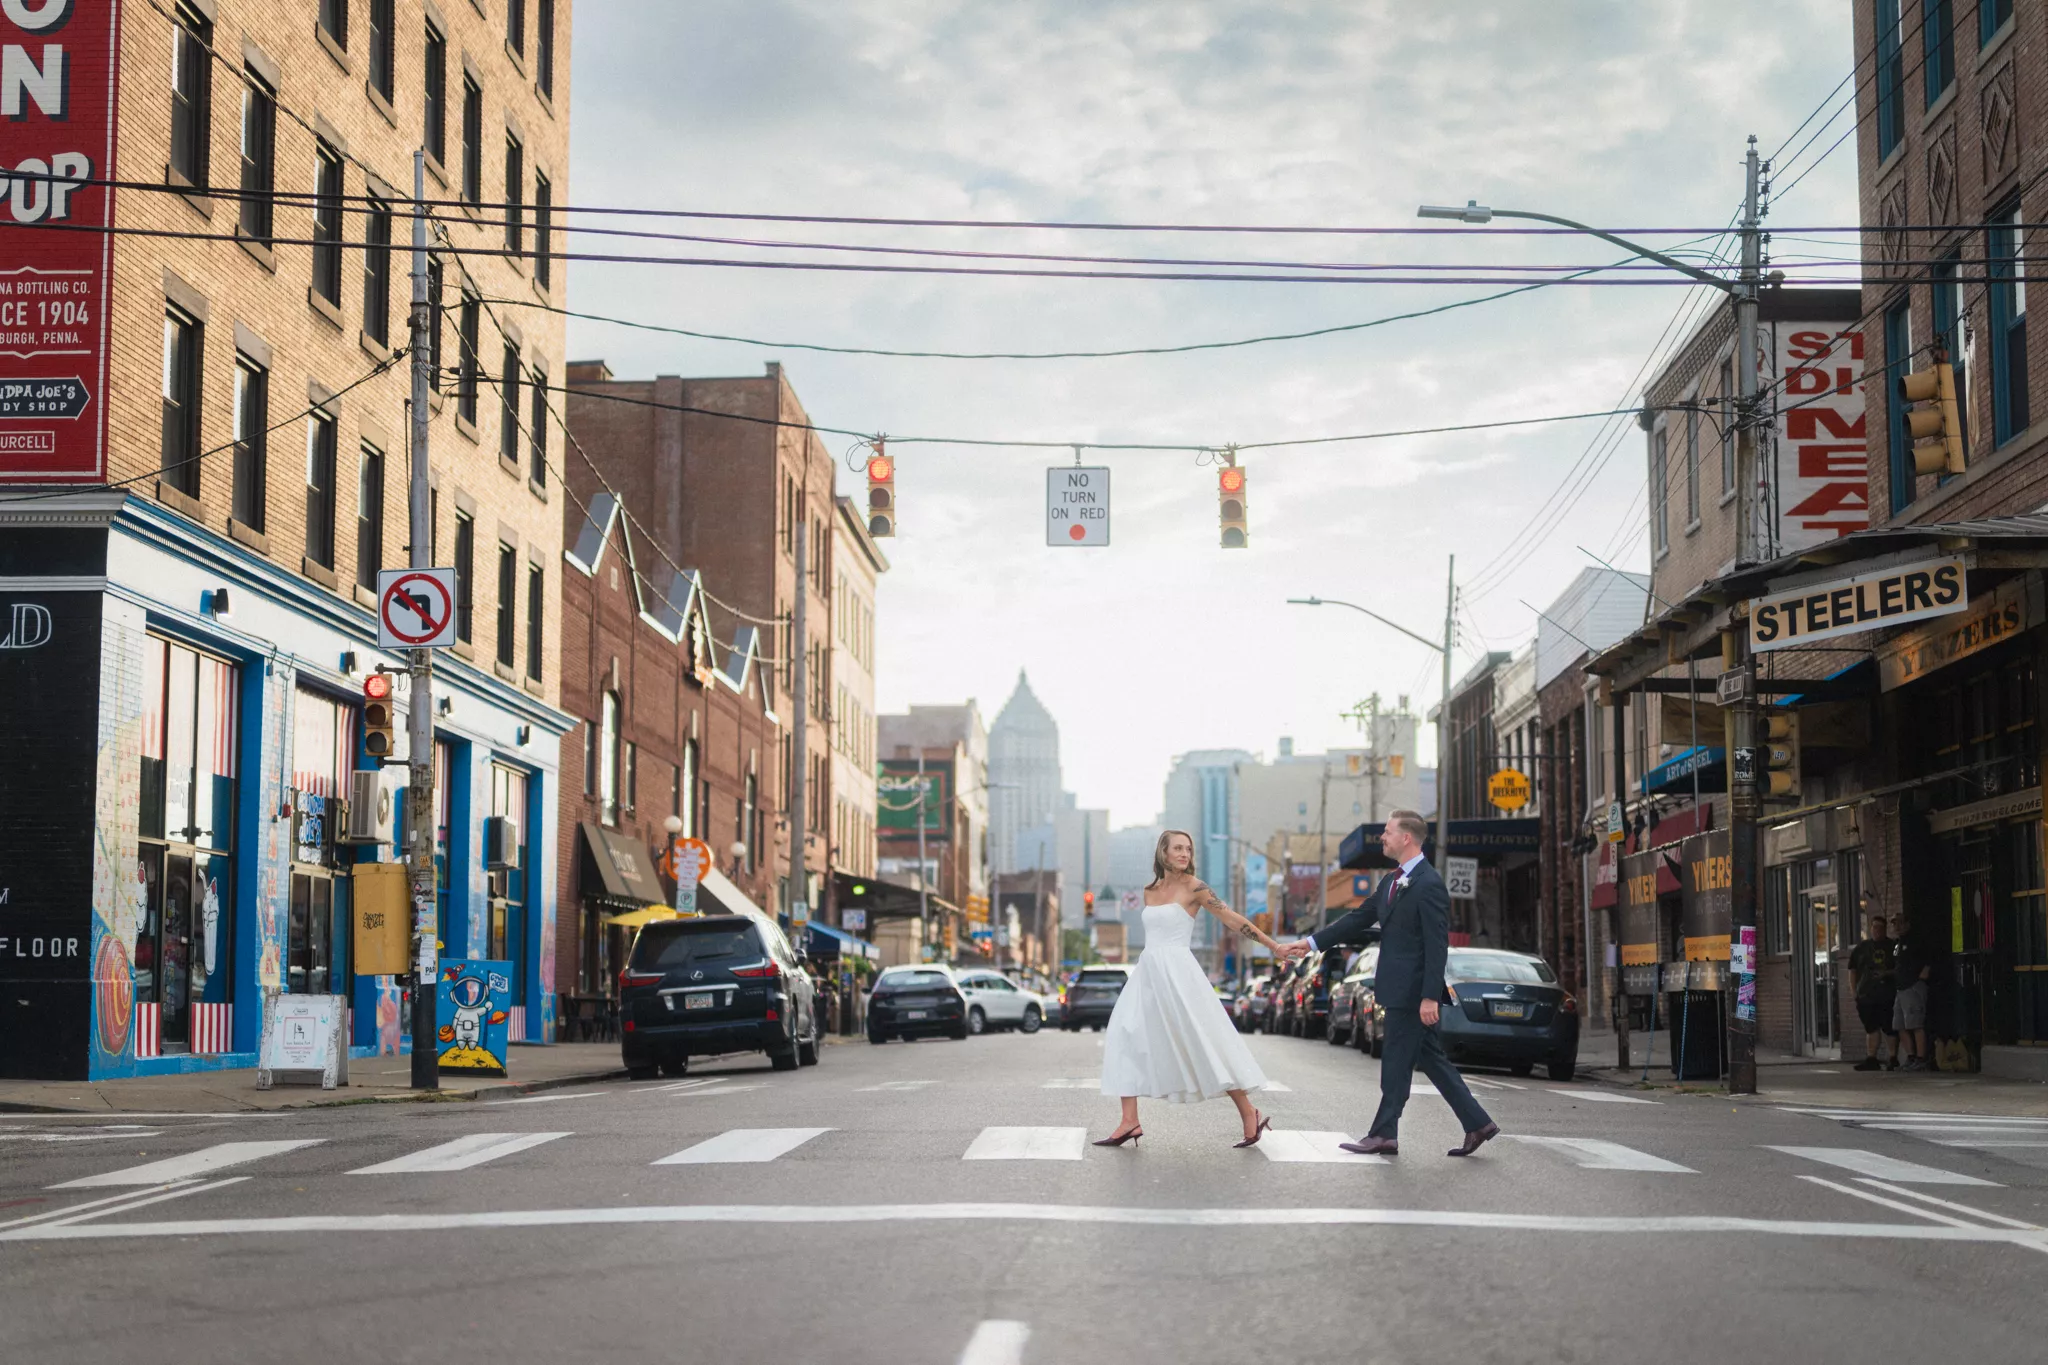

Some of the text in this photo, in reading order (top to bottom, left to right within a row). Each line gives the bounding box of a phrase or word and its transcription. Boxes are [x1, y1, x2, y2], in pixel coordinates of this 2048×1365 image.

[0, 152, 90, 222] OP
[17, 281, 69, 295] BOTTLING
[73, 281, 91, 294] CO.
[38, 301, 89, 326] 1904
[0, 332, 82, 345] BURGH, PENNA.
[1785, 367, 1865, 395] DI
[36, 384, 76, 399] JOE'S
[28, 402, 67, 411] SHOP
[0, 436, 49, 449] URCELL
[1068, 473, 1089, 487] NO
[1062, 491, 1096, 503] TURN
[1051, 507, 1105, 519] ON RED
[1756, 565, 1960, 642] STEELERS
[1900, 601, 2020, 678] YINZERS
[1667, 763, 1680, 781] ART
[1504, 777, 1515, 786] THE
[1450, 862, 1475, 870] SPEED
[1451, 870, 1471, 878] LIMIT
[1450, 878, 1472, 895] 25
